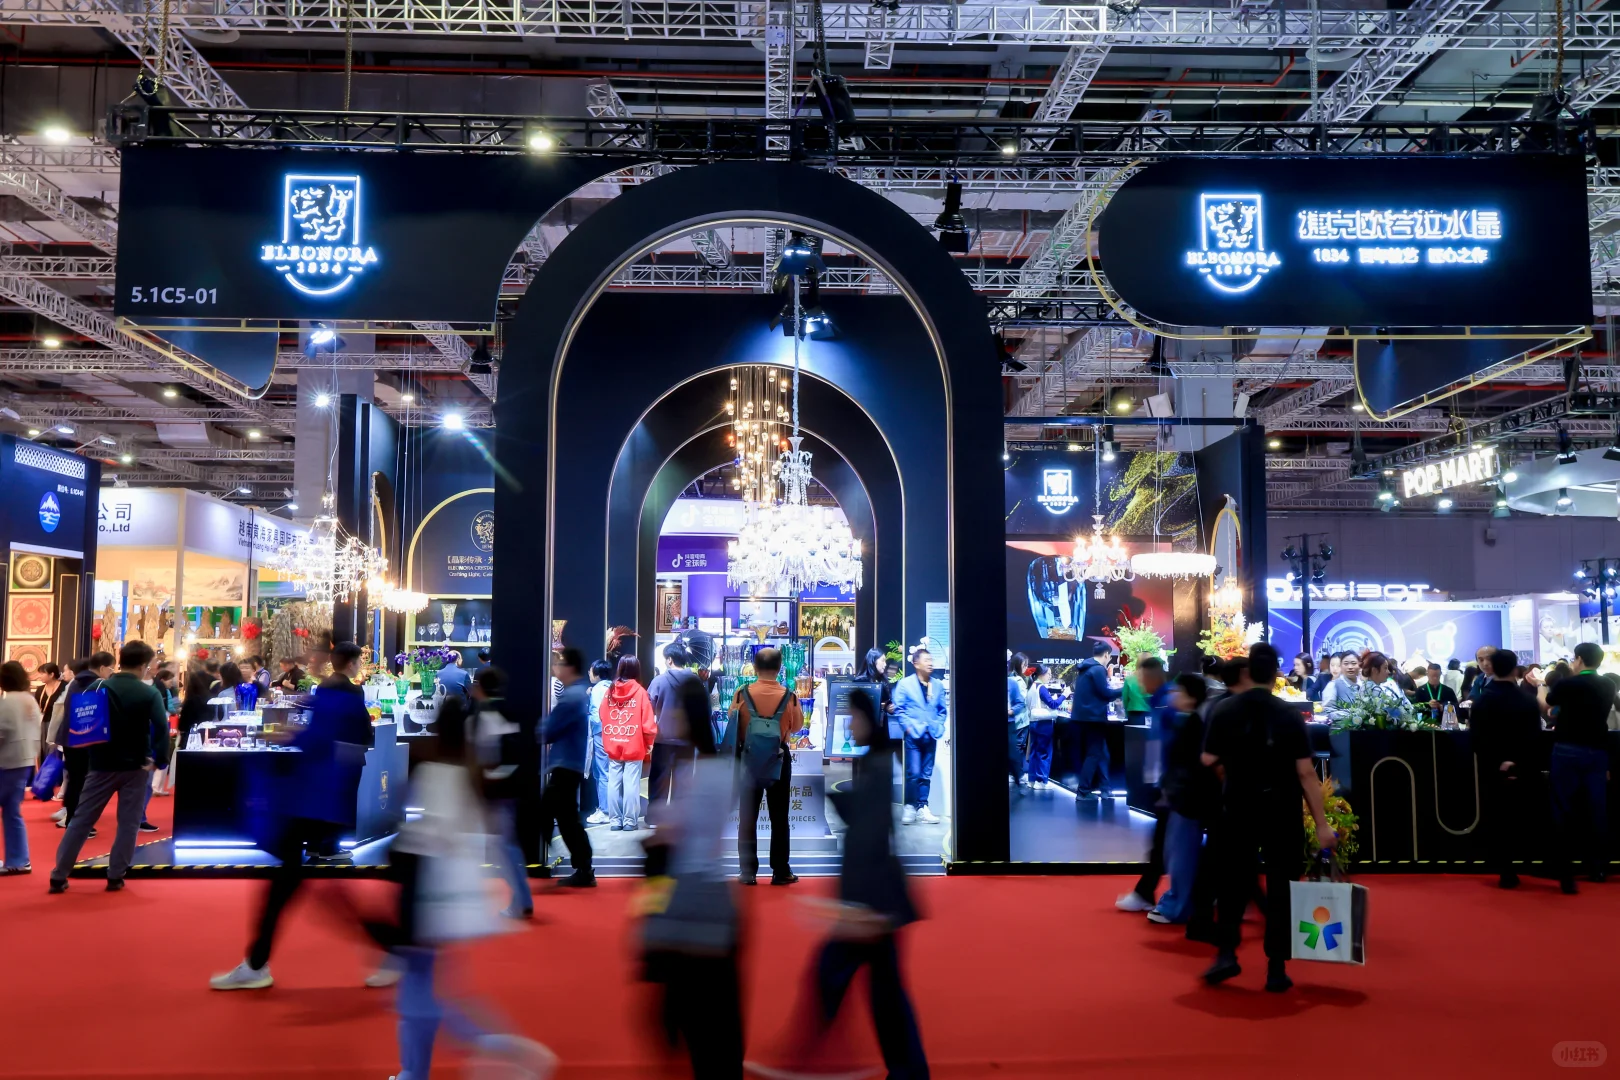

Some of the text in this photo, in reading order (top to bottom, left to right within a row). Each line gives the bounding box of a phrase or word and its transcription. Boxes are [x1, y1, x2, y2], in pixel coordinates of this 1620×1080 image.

[260, 244, 378, 265] ELEONORA
[1186, 251, 1281, 267] ELEONORA
[1314, 248, 1350, 263] 1834
[296, 261, 342, 274] 1834
[131, 286, 218, 304] 5.1C5-01
[1403, 447, 1494, 498] POP MART
[98, 523, 130, 533] o.,Ltd
